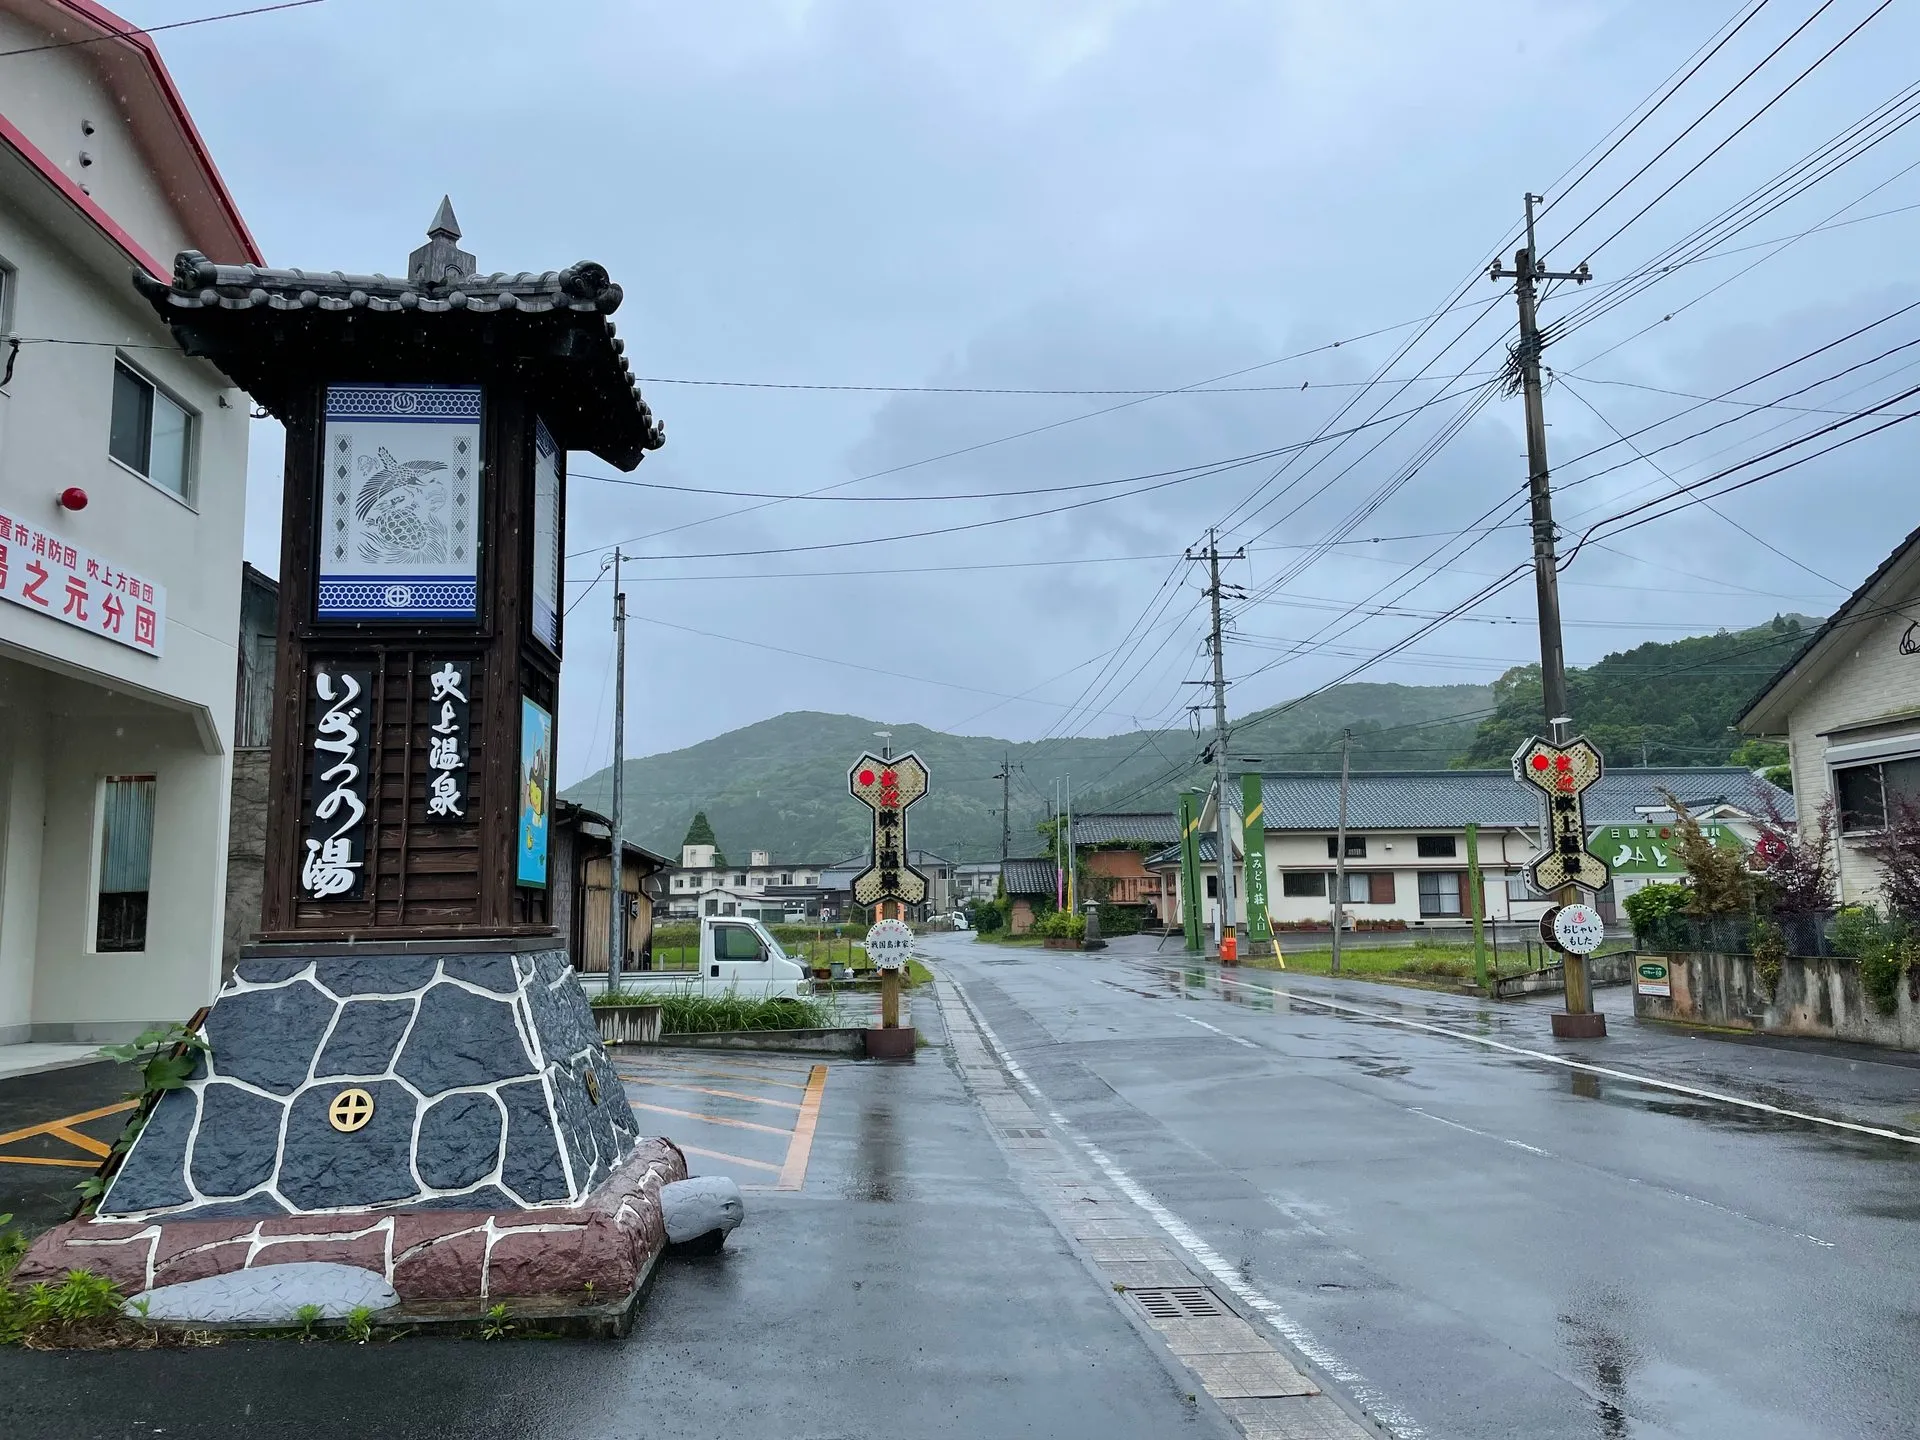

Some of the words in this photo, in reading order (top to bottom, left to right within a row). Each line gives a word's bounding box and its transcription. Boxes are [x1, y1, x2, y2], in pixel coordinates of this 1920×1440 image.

[0, 515, 77, 571] 置市消防団
[87, 558, 153, 605] 吹上方面団
[427, 662, 468, 816] 吹上温泉
[879, 810, 900, 891] 吹上温泉
[1251, 859, 1264, 905] みどり荘
[1563, 925, 1597, 934] おじゃい
[1569, 936, 1592, 946] もした
